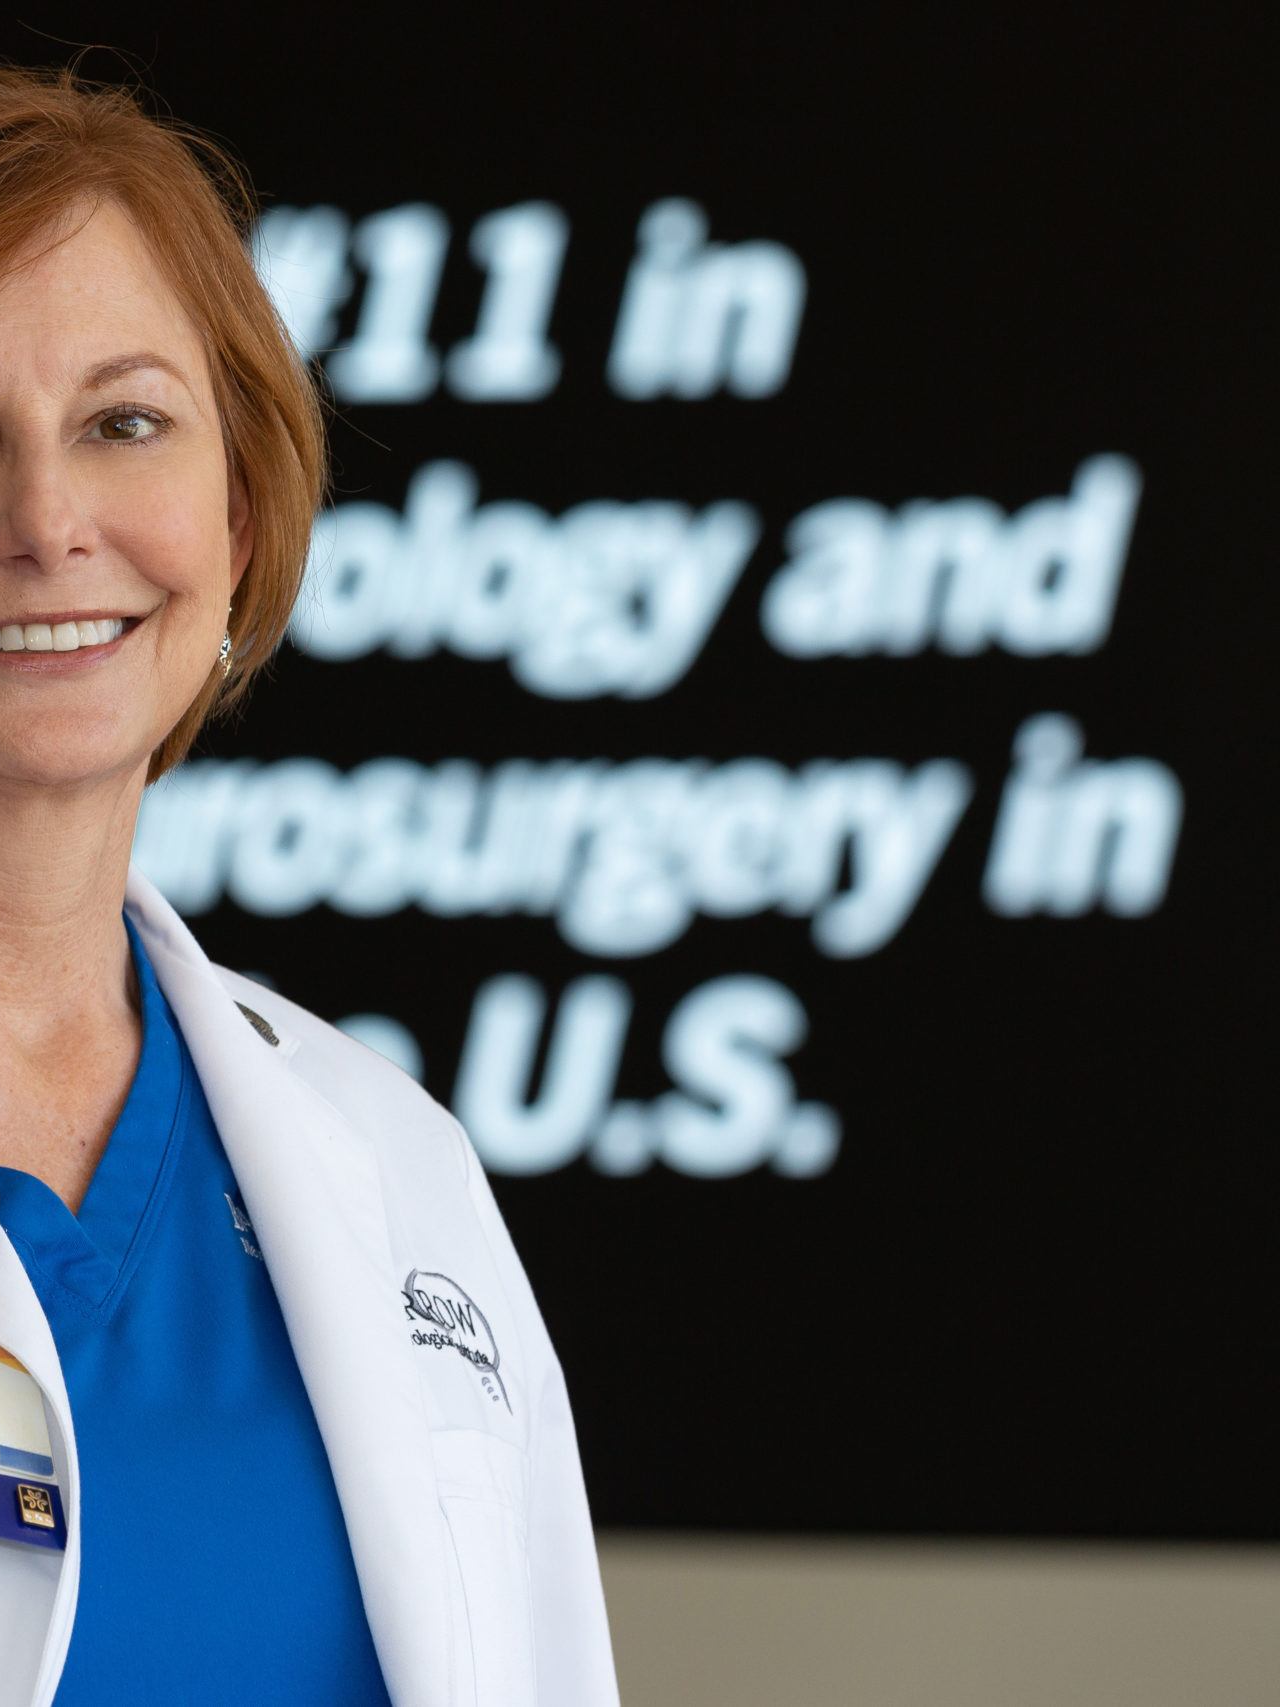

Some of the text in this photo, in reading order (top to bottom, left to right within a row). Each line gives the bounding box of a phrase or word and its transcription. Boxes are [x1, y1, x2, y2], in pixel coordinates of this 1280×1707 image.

[608, 198, 807, 399] in
[288, 453, 1142, 698] ology and
[132, 712, 1184, 958] rosurgery in
[452, 974, 840, 1181] U.S.
